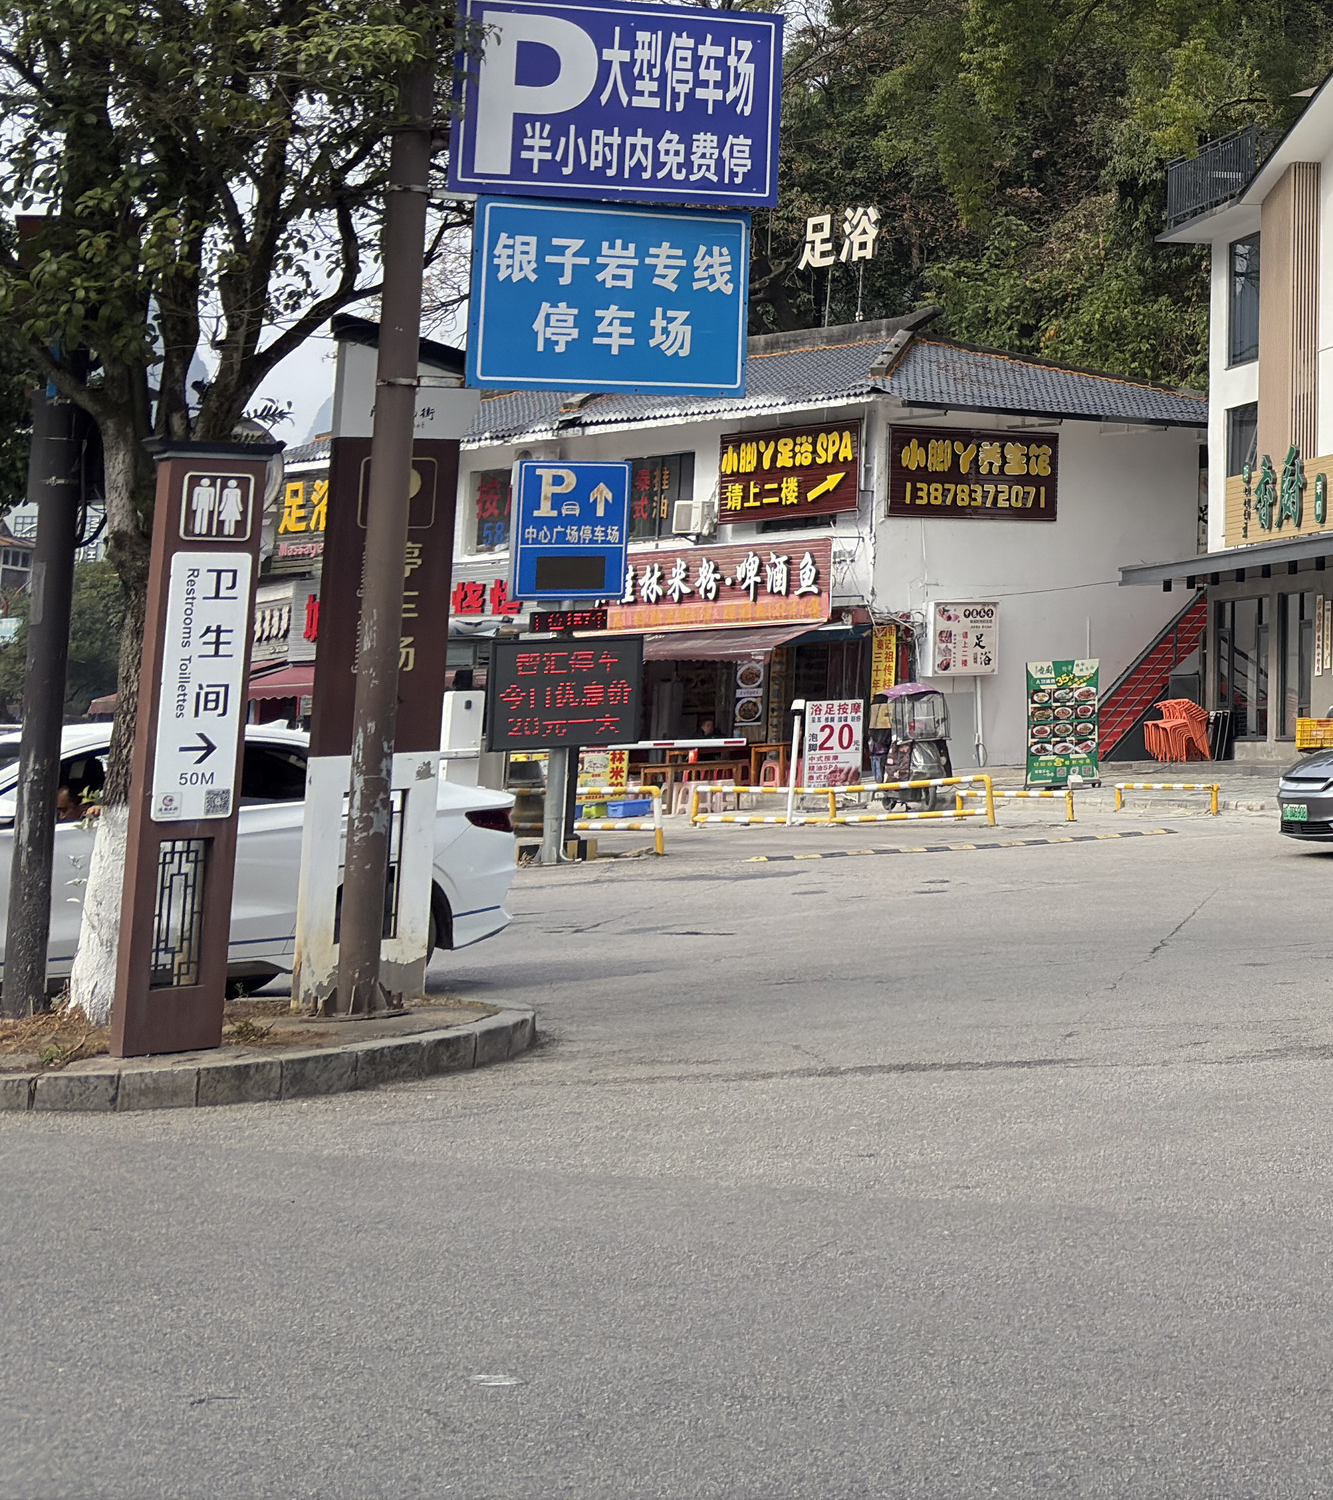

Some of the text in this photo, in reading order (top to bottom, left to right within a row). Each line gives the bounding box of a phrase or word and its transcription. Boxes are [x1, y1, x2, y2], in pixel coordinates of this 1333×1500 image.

[474, 10, 598, 175] P
[600, 26, 755, 116] 大型停车场
[520, 122, 752, 184] 半小时内免费停
[493, 232, 734, 295] 银子岩专线
[797, 206, 881, 271] 足浴
[532, 301, 692, 357] 停车场
[533, 468, 577, 517] P
[726, 477, 799, 511] 请上二楼
[905, 482, 1045, 508] 13878372071
[278, 543, 324, 558] Massage
[525, 525, 619, 544] 中心广场停车场
[594, 551, 819, 607] 桂林米粉·啤酒鱼
[175, 568, 200, 719] Restrooms Toillettes
[194, 569, 238, 718] 卫生间
[811, 702, 861, 716] 浴足按摩
[818, 723, 853, 751] 20
[179, 771, 215, 786] 50M
